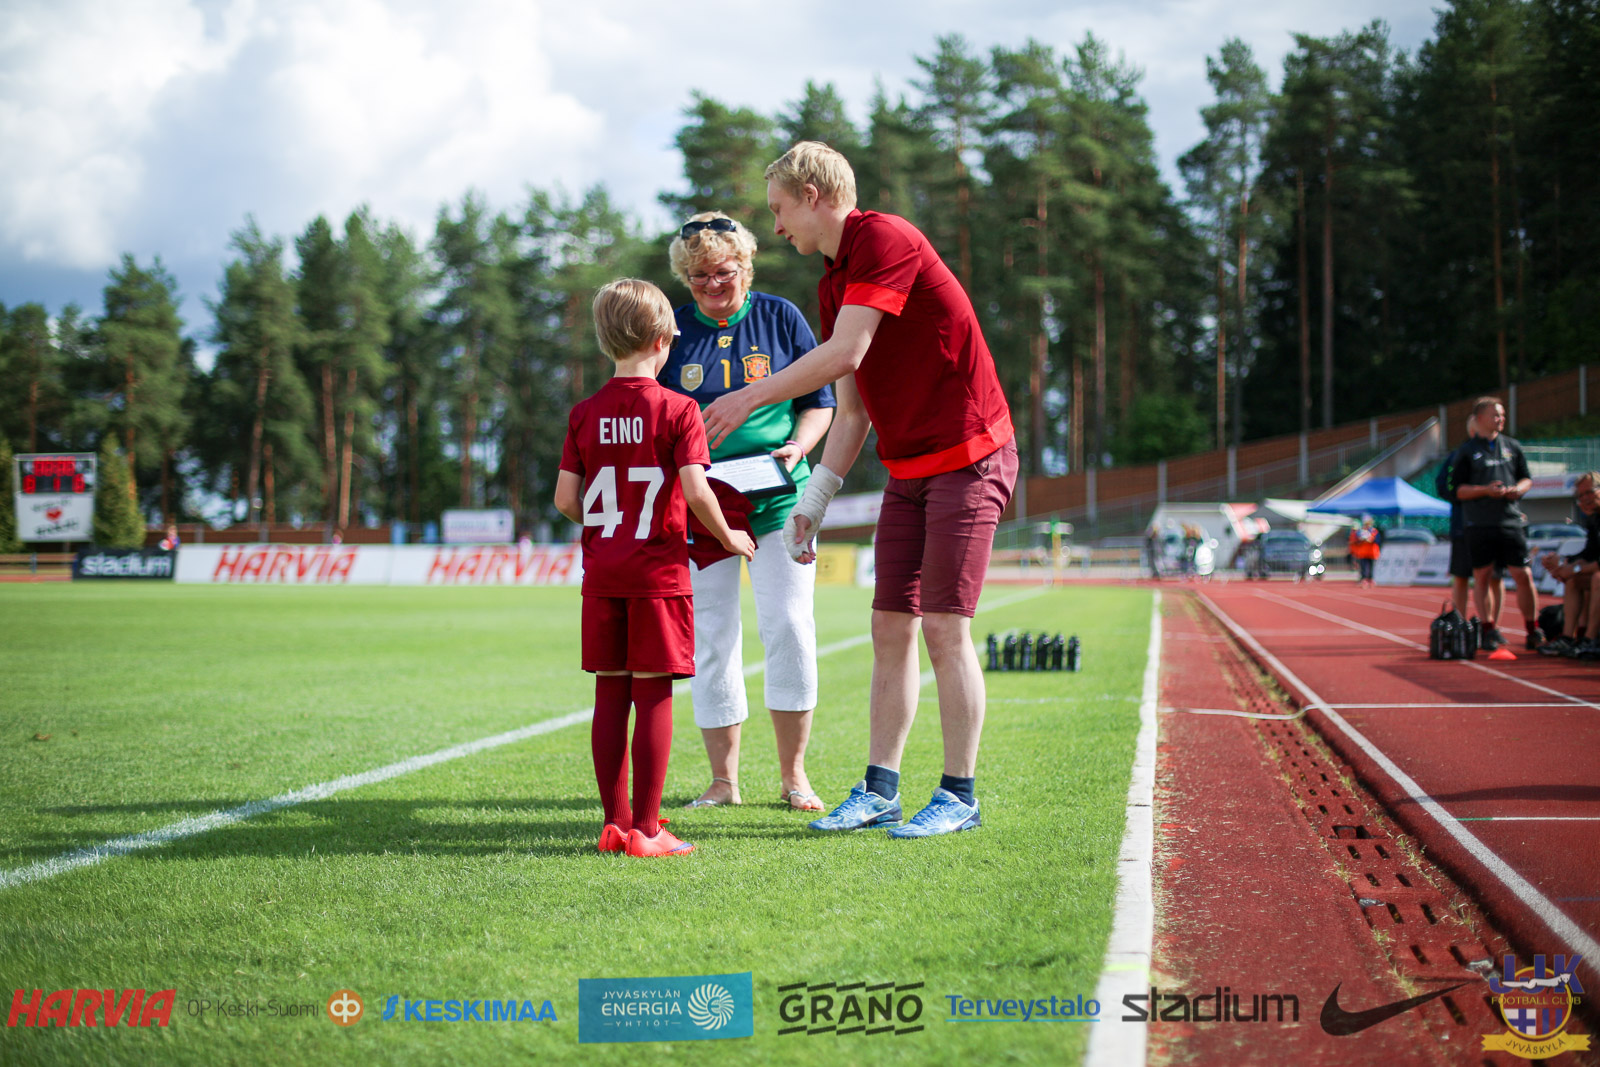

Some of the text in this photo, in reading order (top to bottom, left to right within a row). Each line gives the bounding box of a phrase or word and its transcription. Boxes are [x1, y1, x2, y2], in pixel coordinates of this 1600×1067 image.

[721, 359, 731, 388] 1
[600, 417, 643, 444] EINO
[583, 466, 665, 539] 47
[81, 553, 171, 576] stadium
[212, 545, 359, 583] HARVIA
[428, 545, 581, 584] HARVIA
